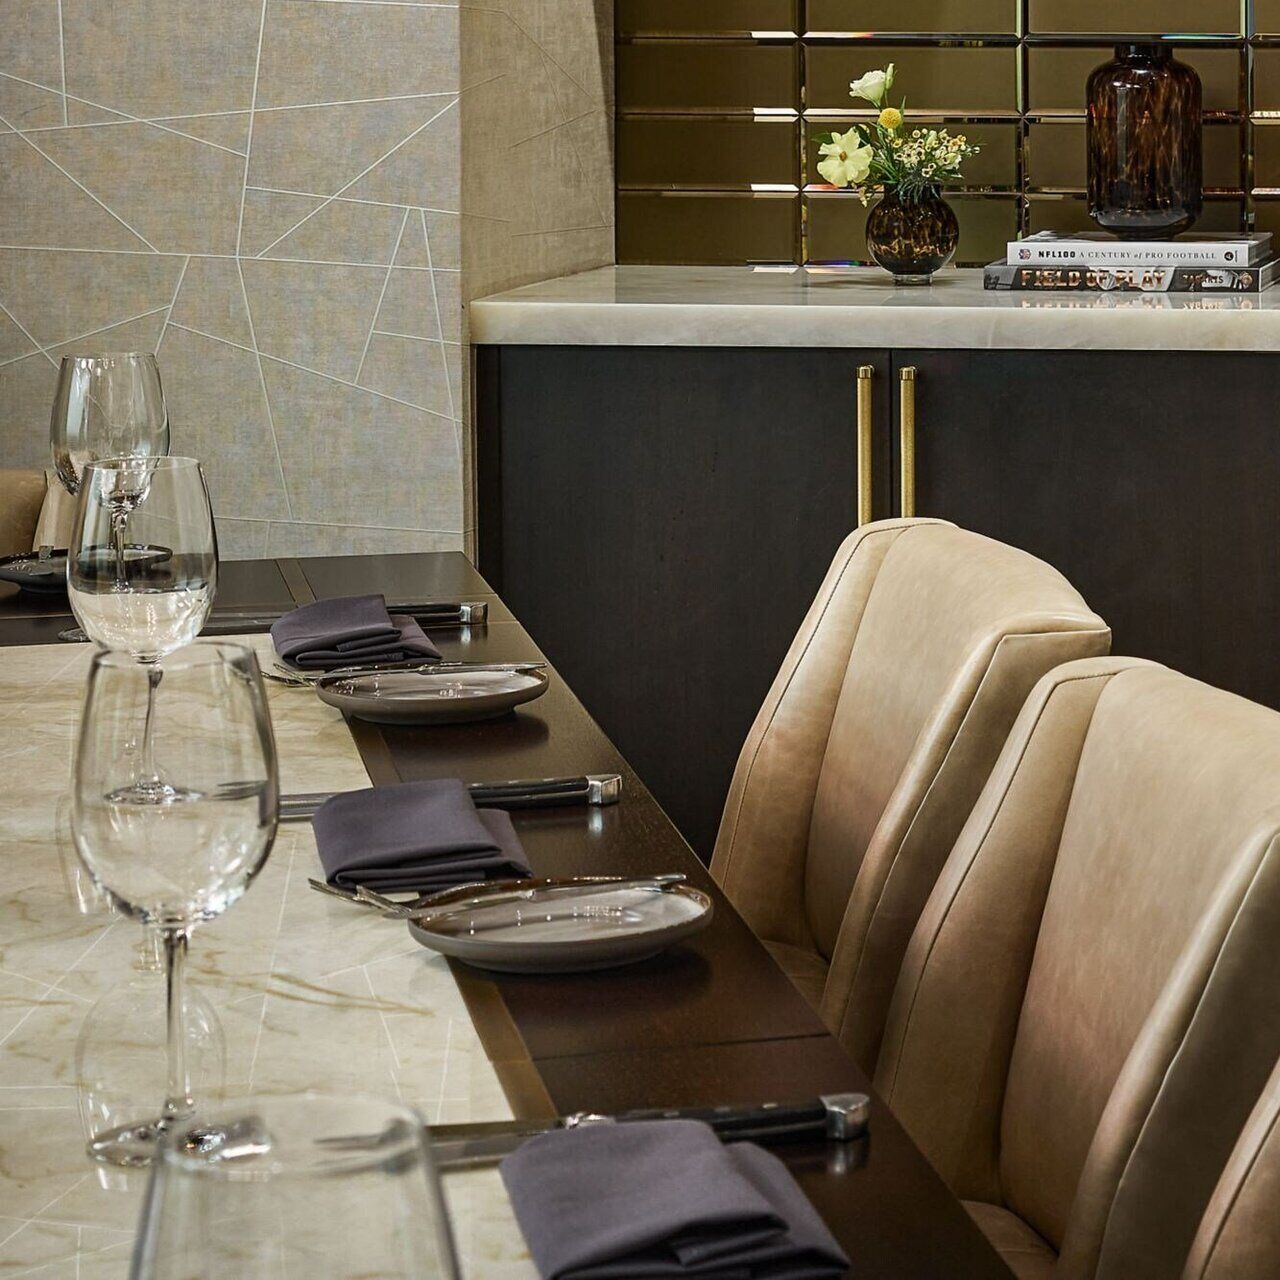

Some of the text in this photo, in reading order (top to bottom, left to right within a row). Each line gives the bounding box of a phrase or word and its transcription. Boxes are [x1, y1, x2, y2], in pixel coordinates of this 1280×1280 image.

[1134, 252, 1142, 260] of
[1021, 270, 1166, 288] FIELD OF PLAY
